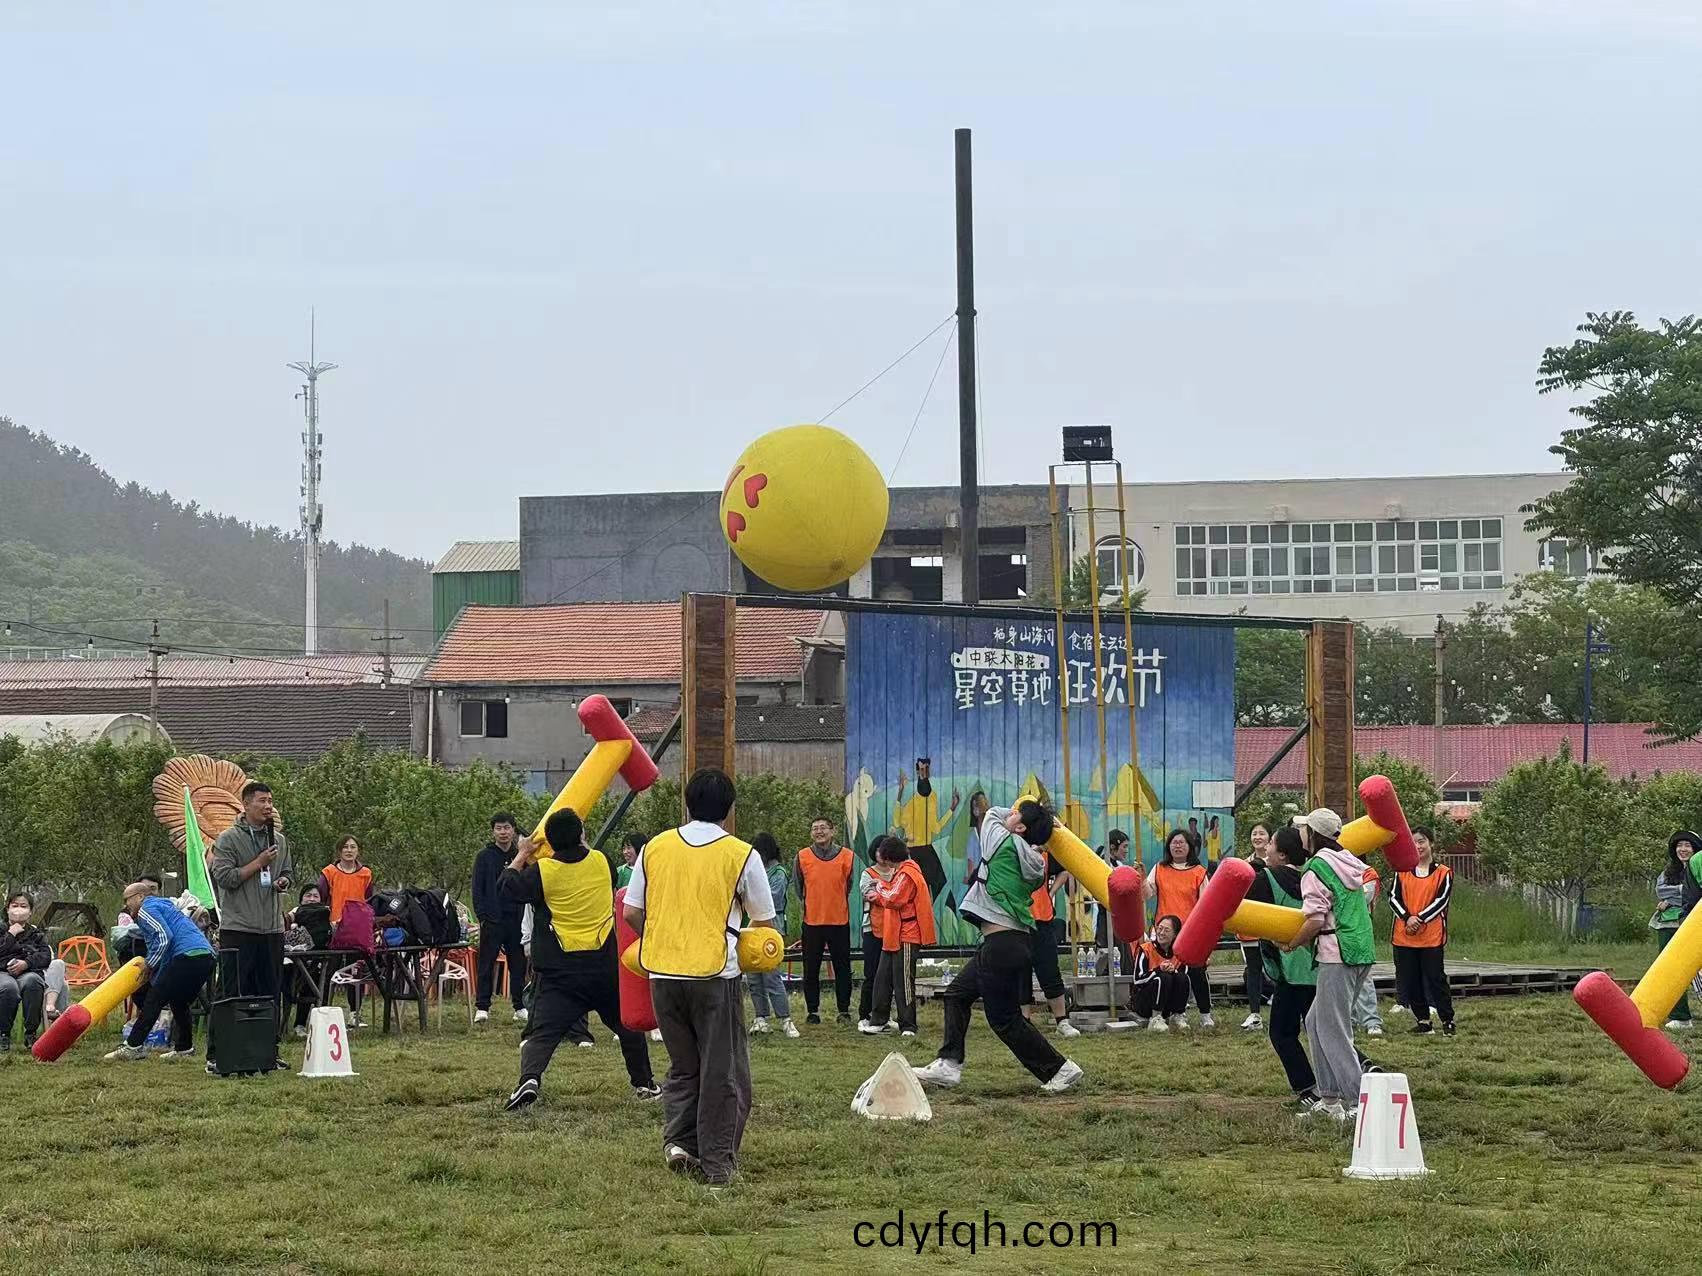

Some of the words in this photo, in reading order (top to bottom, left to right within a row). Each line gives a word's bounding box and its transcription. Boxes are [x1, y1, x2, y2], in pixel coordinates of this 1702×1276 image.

[969, 649, 1036, 669] 中联太阳花
[993, 625, 1055, 648] 栖身山海间
[954, 670, 1052, 710] 星空草地
[1057, 648, 1168, 708] 狂欢节
[328, 1023, 342, 1062] 3
[1358, 1093, 1369, 1148] 7
[1391, 1093, 1408, 1149] 7
